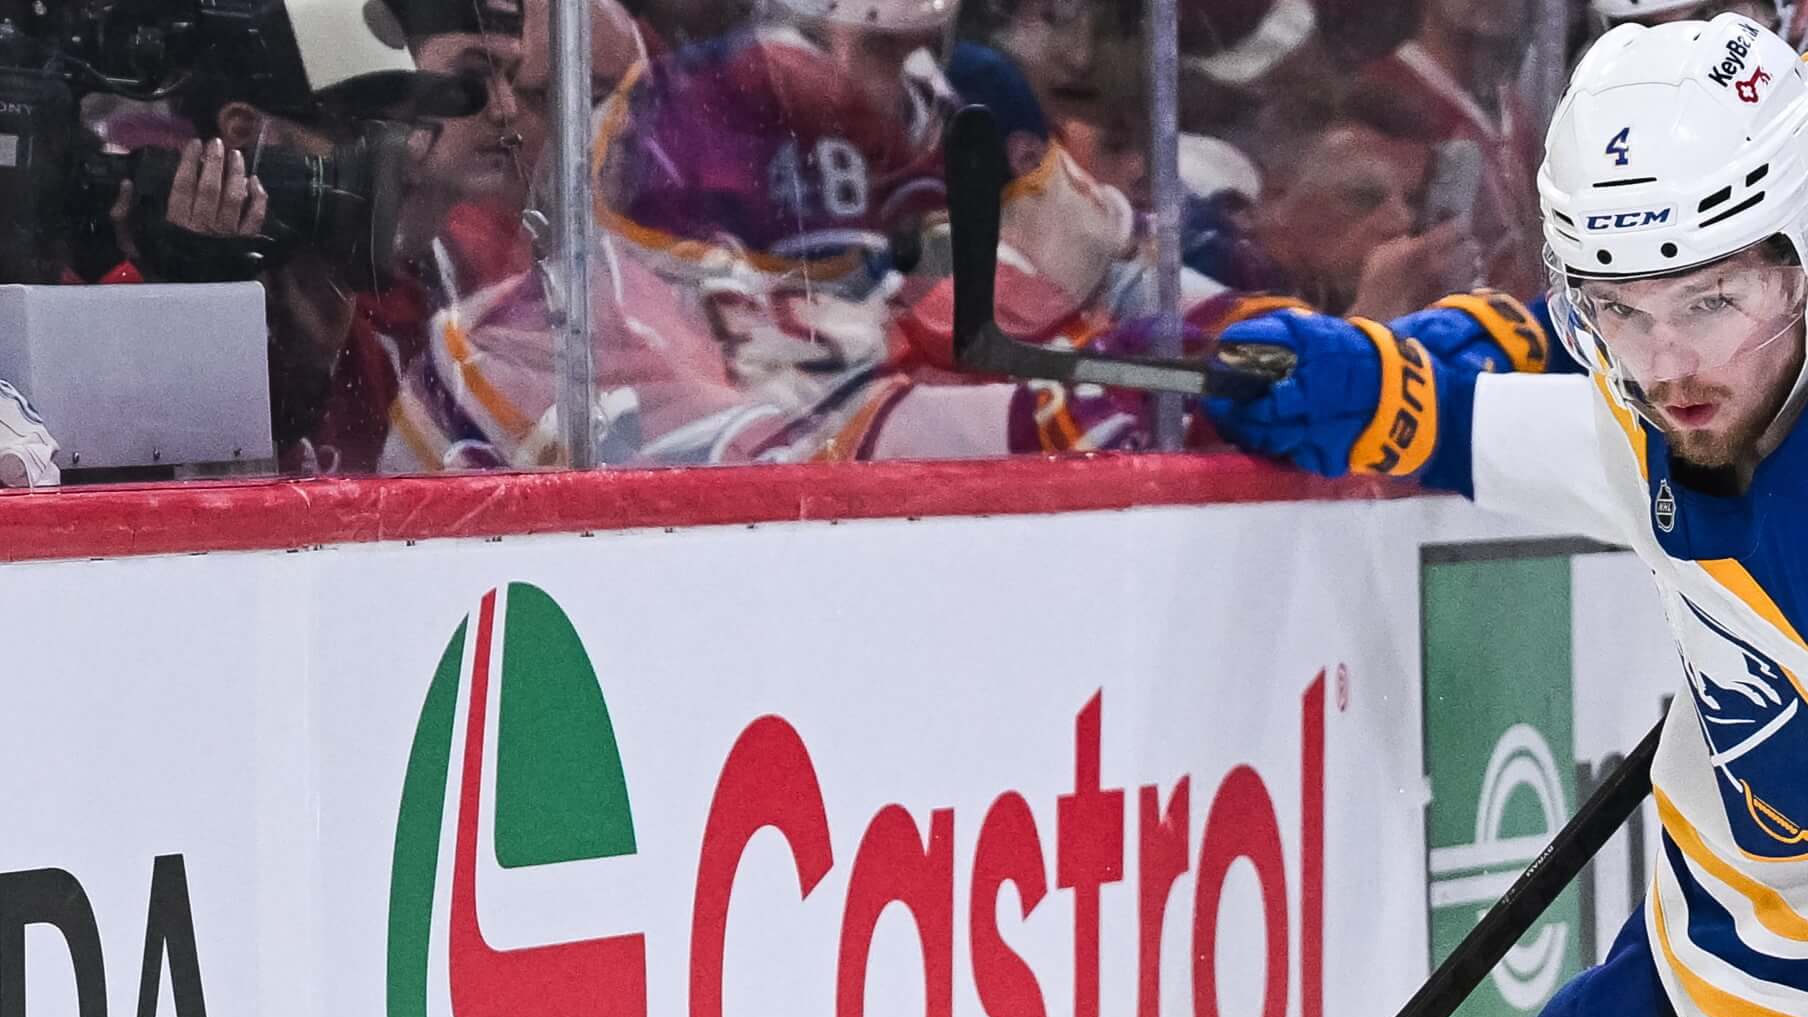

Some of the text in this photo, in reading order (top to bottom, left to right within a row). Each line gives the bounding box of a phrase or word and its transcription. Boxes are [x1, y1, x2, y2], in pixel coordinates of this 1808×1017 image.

[0, 100, 33, 116] ONY
[1605, 127, 1630, 166] 4
[1586, 207, 1671, 230] CCM
